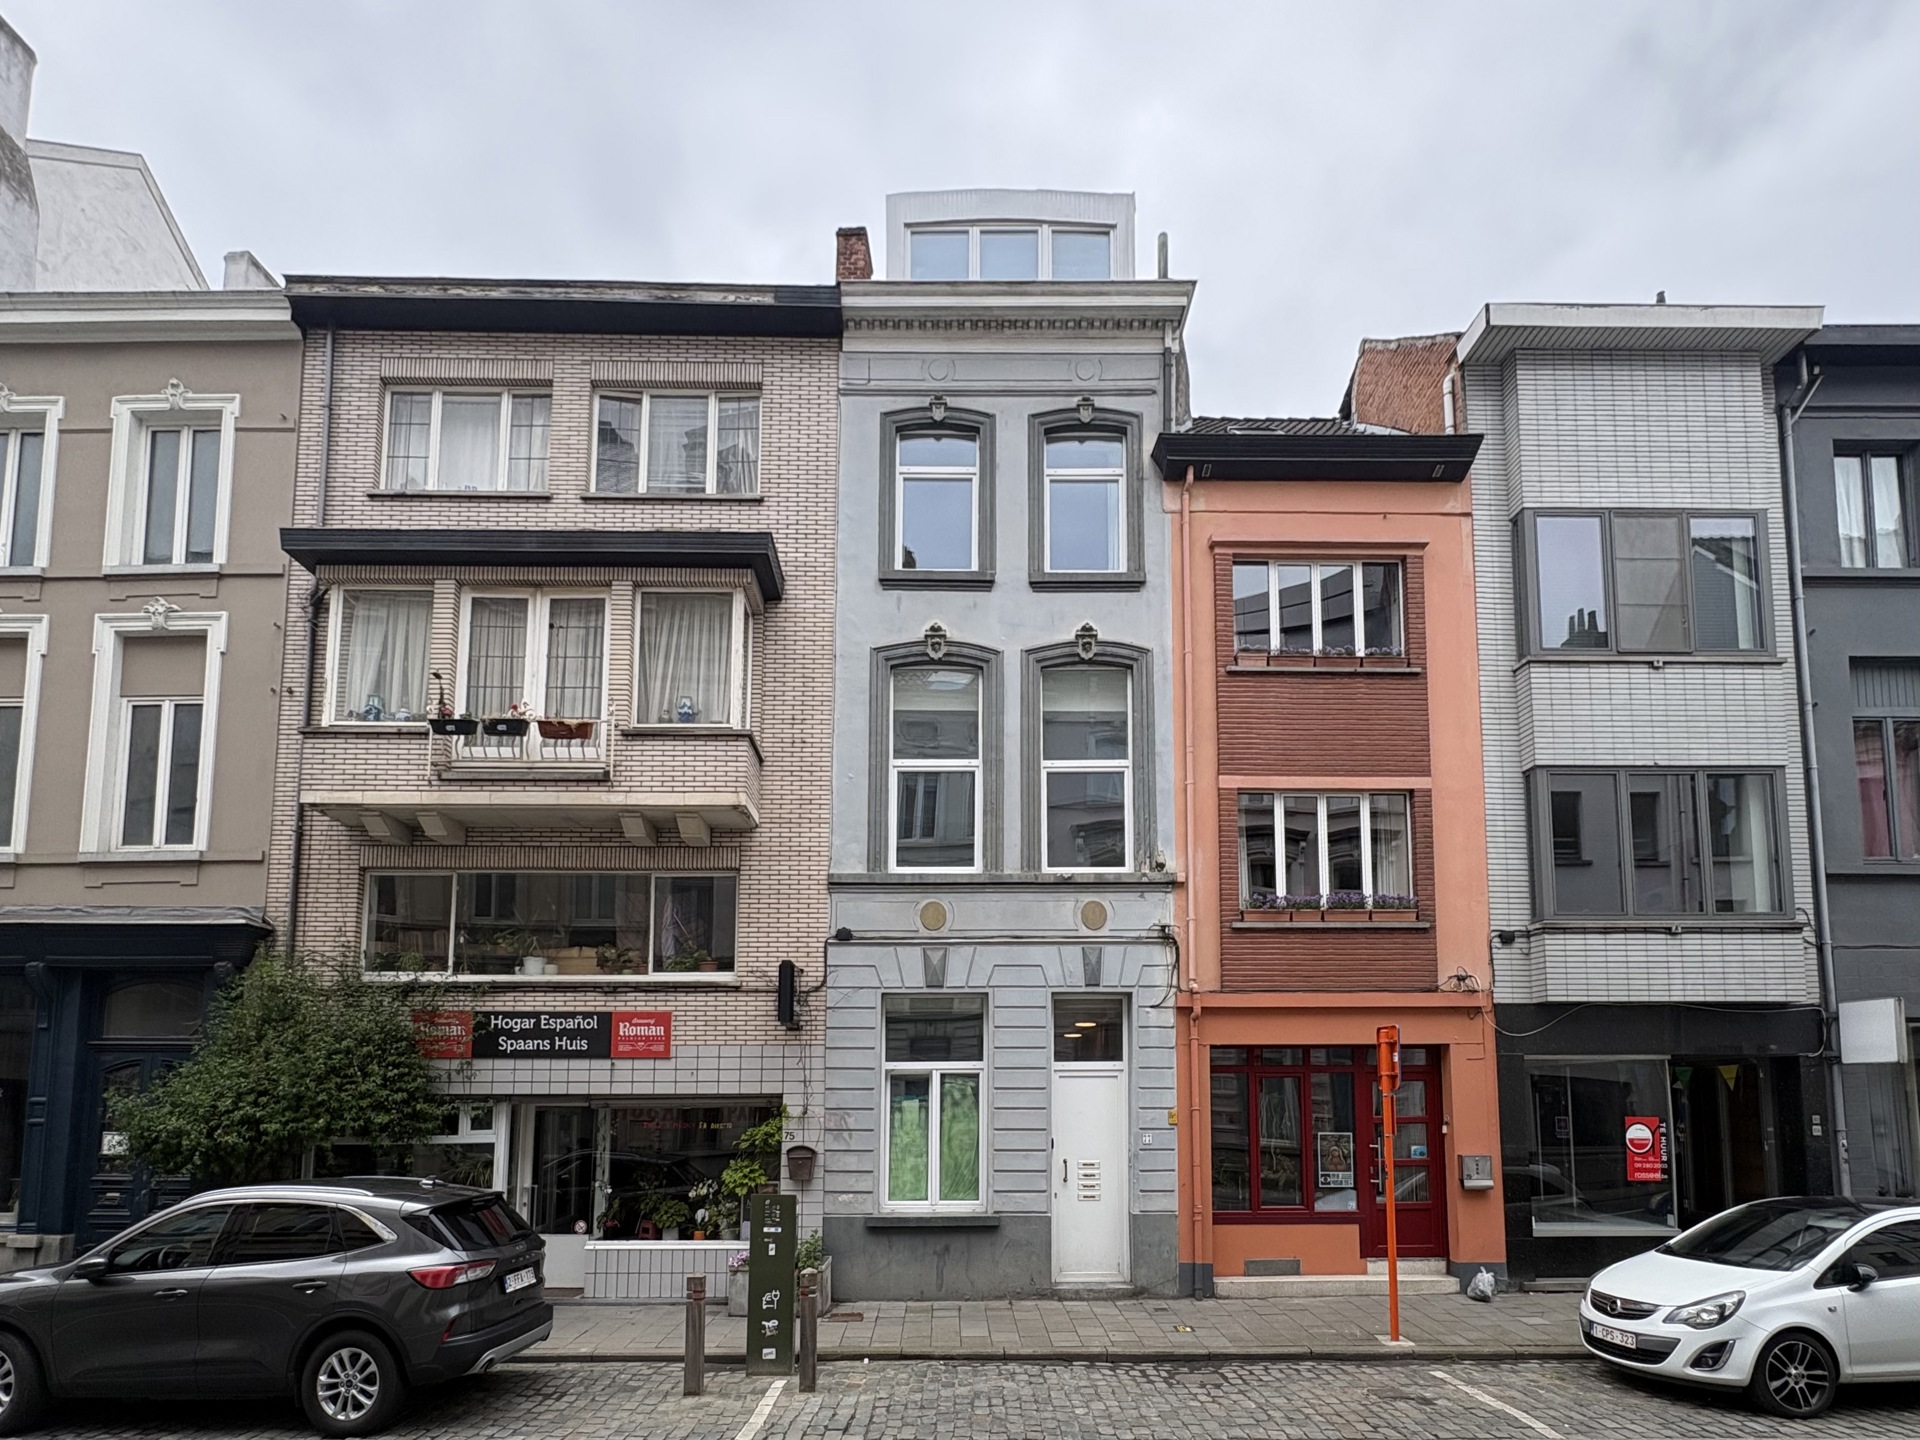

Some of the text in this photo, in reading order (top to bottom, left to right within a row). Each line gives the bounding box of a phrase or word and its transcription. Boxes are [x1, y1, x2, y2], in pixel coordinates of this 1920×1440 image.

[490, 1015, 598, 1032] Hogar Español
[618, 1022, 665, 1036] Roman
[498, 1036, 588, 1053] Spaans Huis
[784, 1131, 795, 1141] 75
[1660, 1123, 1668, 1162] TE HUUR
[1594, 1325, 1635, 1346] 1-CPS-323
